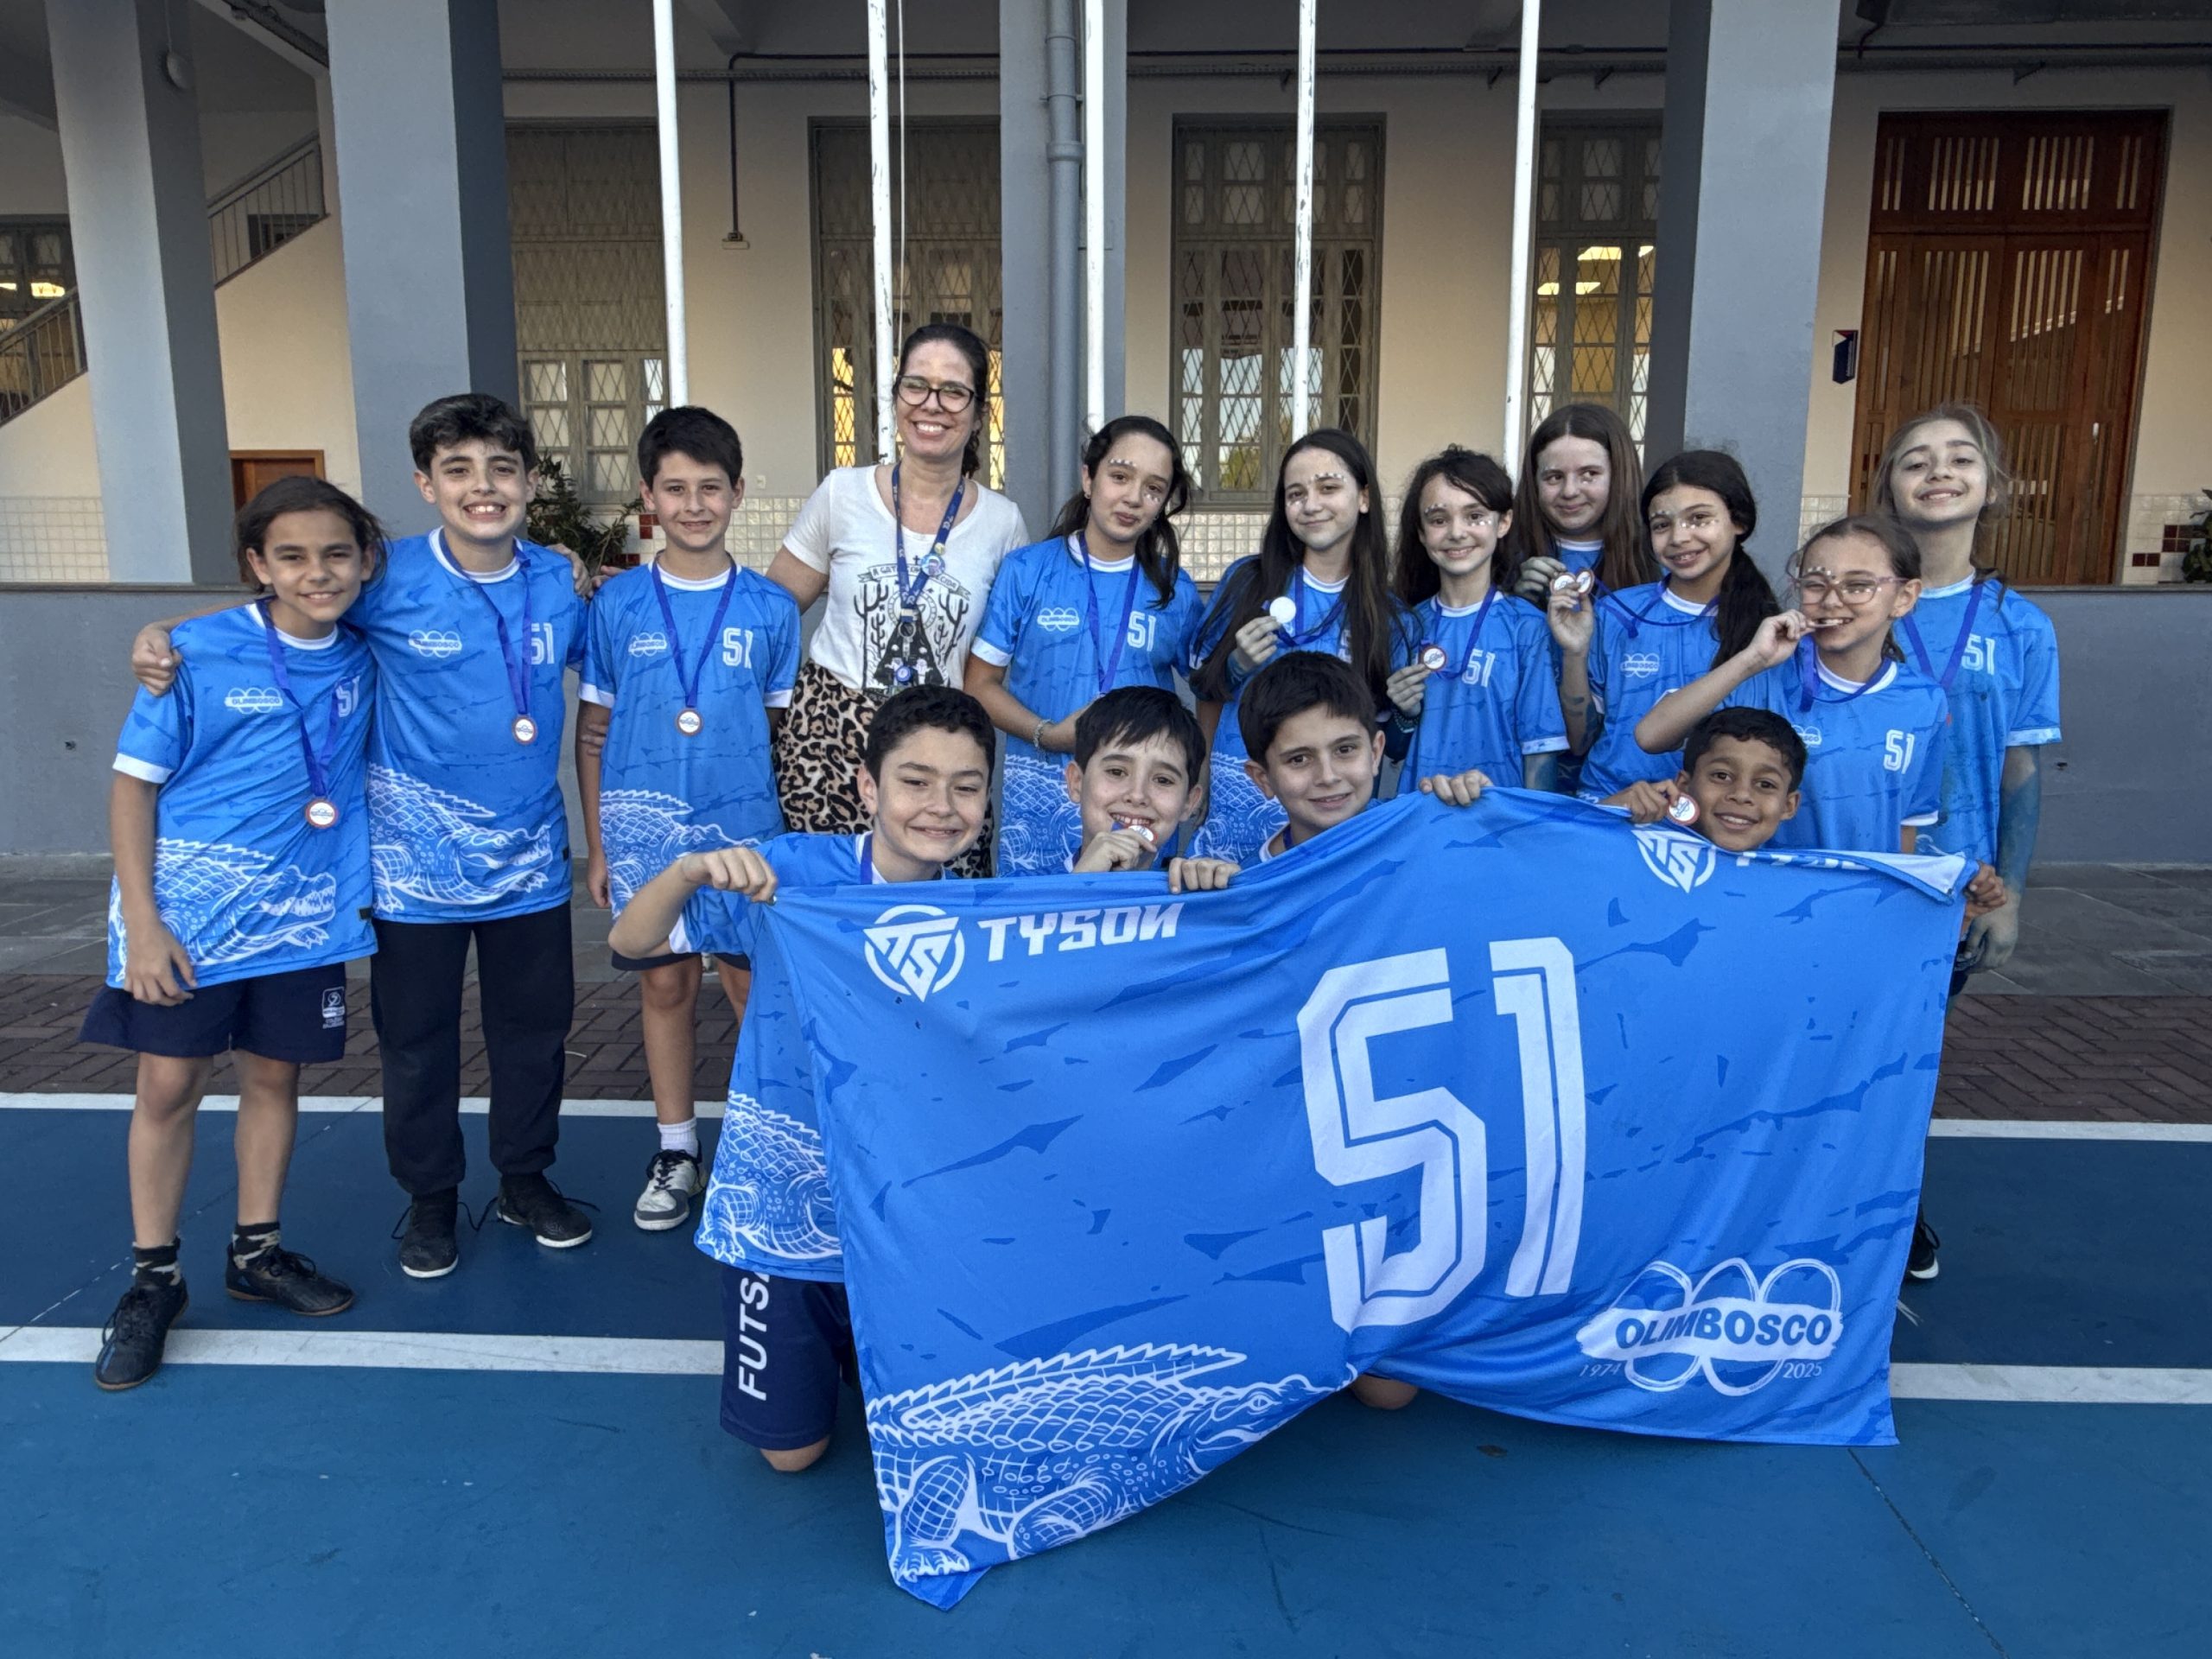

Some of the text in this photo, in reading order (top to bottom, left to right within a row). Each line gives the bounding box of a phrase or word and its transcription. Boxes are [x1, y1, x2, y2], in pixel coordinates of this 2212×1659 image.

[531, 622, 555, 664] 51
[722, 627, 753, 669] 51
[1127, 610, 1156, 652] 51
[1461, 648, 1496, 688] 51
[1961, 632, 1996, 676] 51
[334, 676, 360, 718] 51
[1884, 729, 1915, 774] 51
[977, 902, 1185, 963] TYSON
[1296, 936, 1586, 1336] 51
[1615, 1306, 1833, 1350] OLIMBOSCO
[1579, 1362, 1622, 1378] 1974
[1783, 1362, 1822, 1379] 2025
